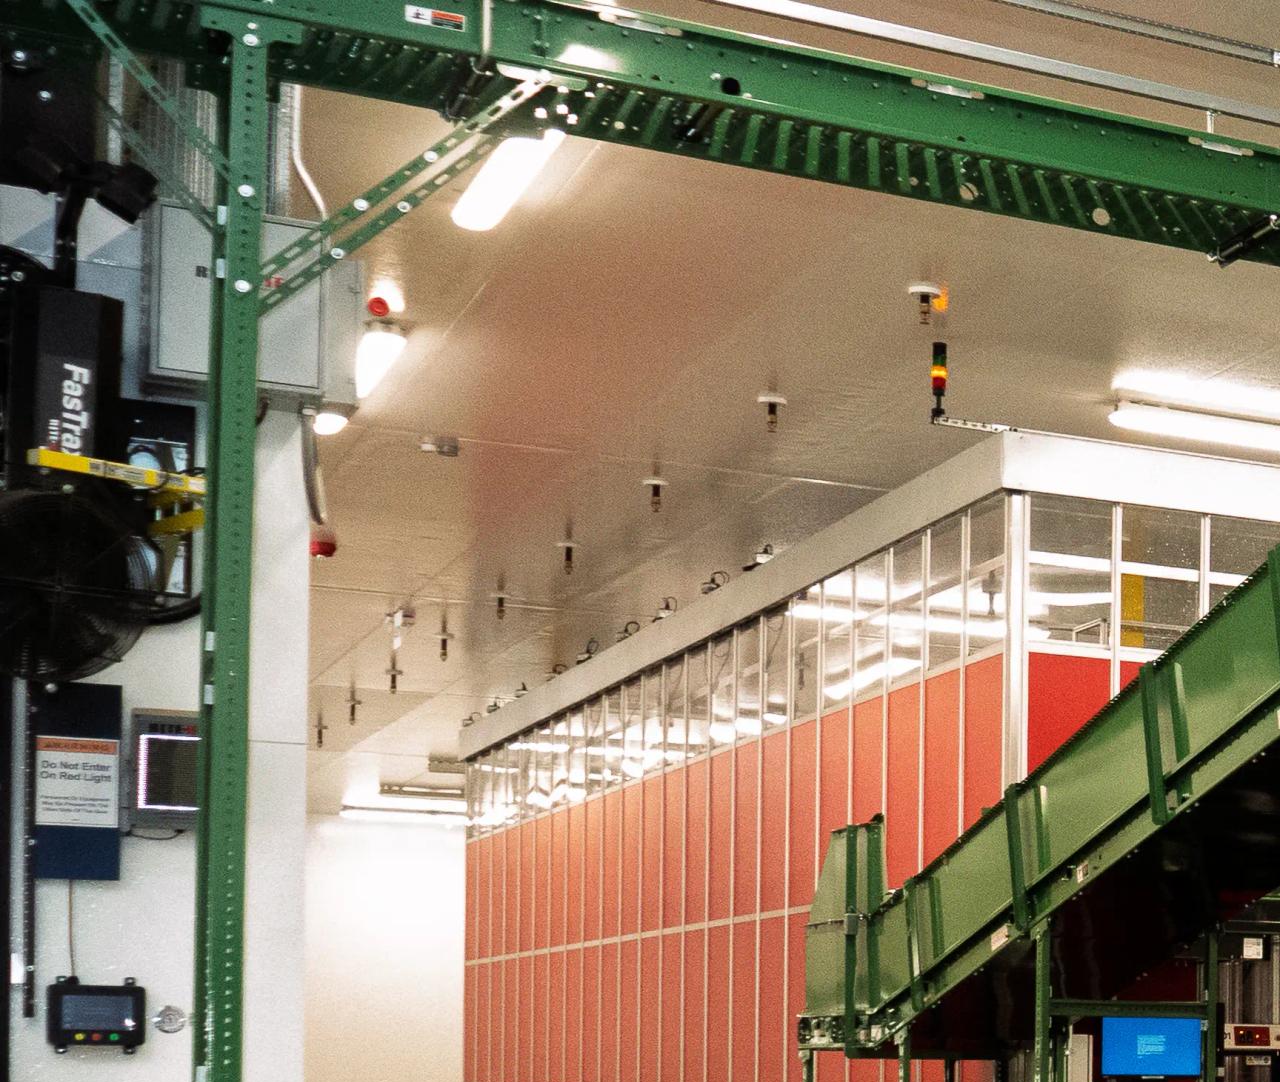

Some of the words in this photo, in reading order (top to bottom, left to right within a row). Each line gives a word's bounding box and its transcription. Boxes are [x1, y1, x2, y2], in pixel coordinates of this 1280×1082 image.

[41, 760, 57, 769] Do
[60, 761, 79, 770] Not
[82, 762, 112, 772] Enter
[40, 771, 56, 780] On
[59, 772, 81, 781] Red
[84, 773, 112, 784] Light
